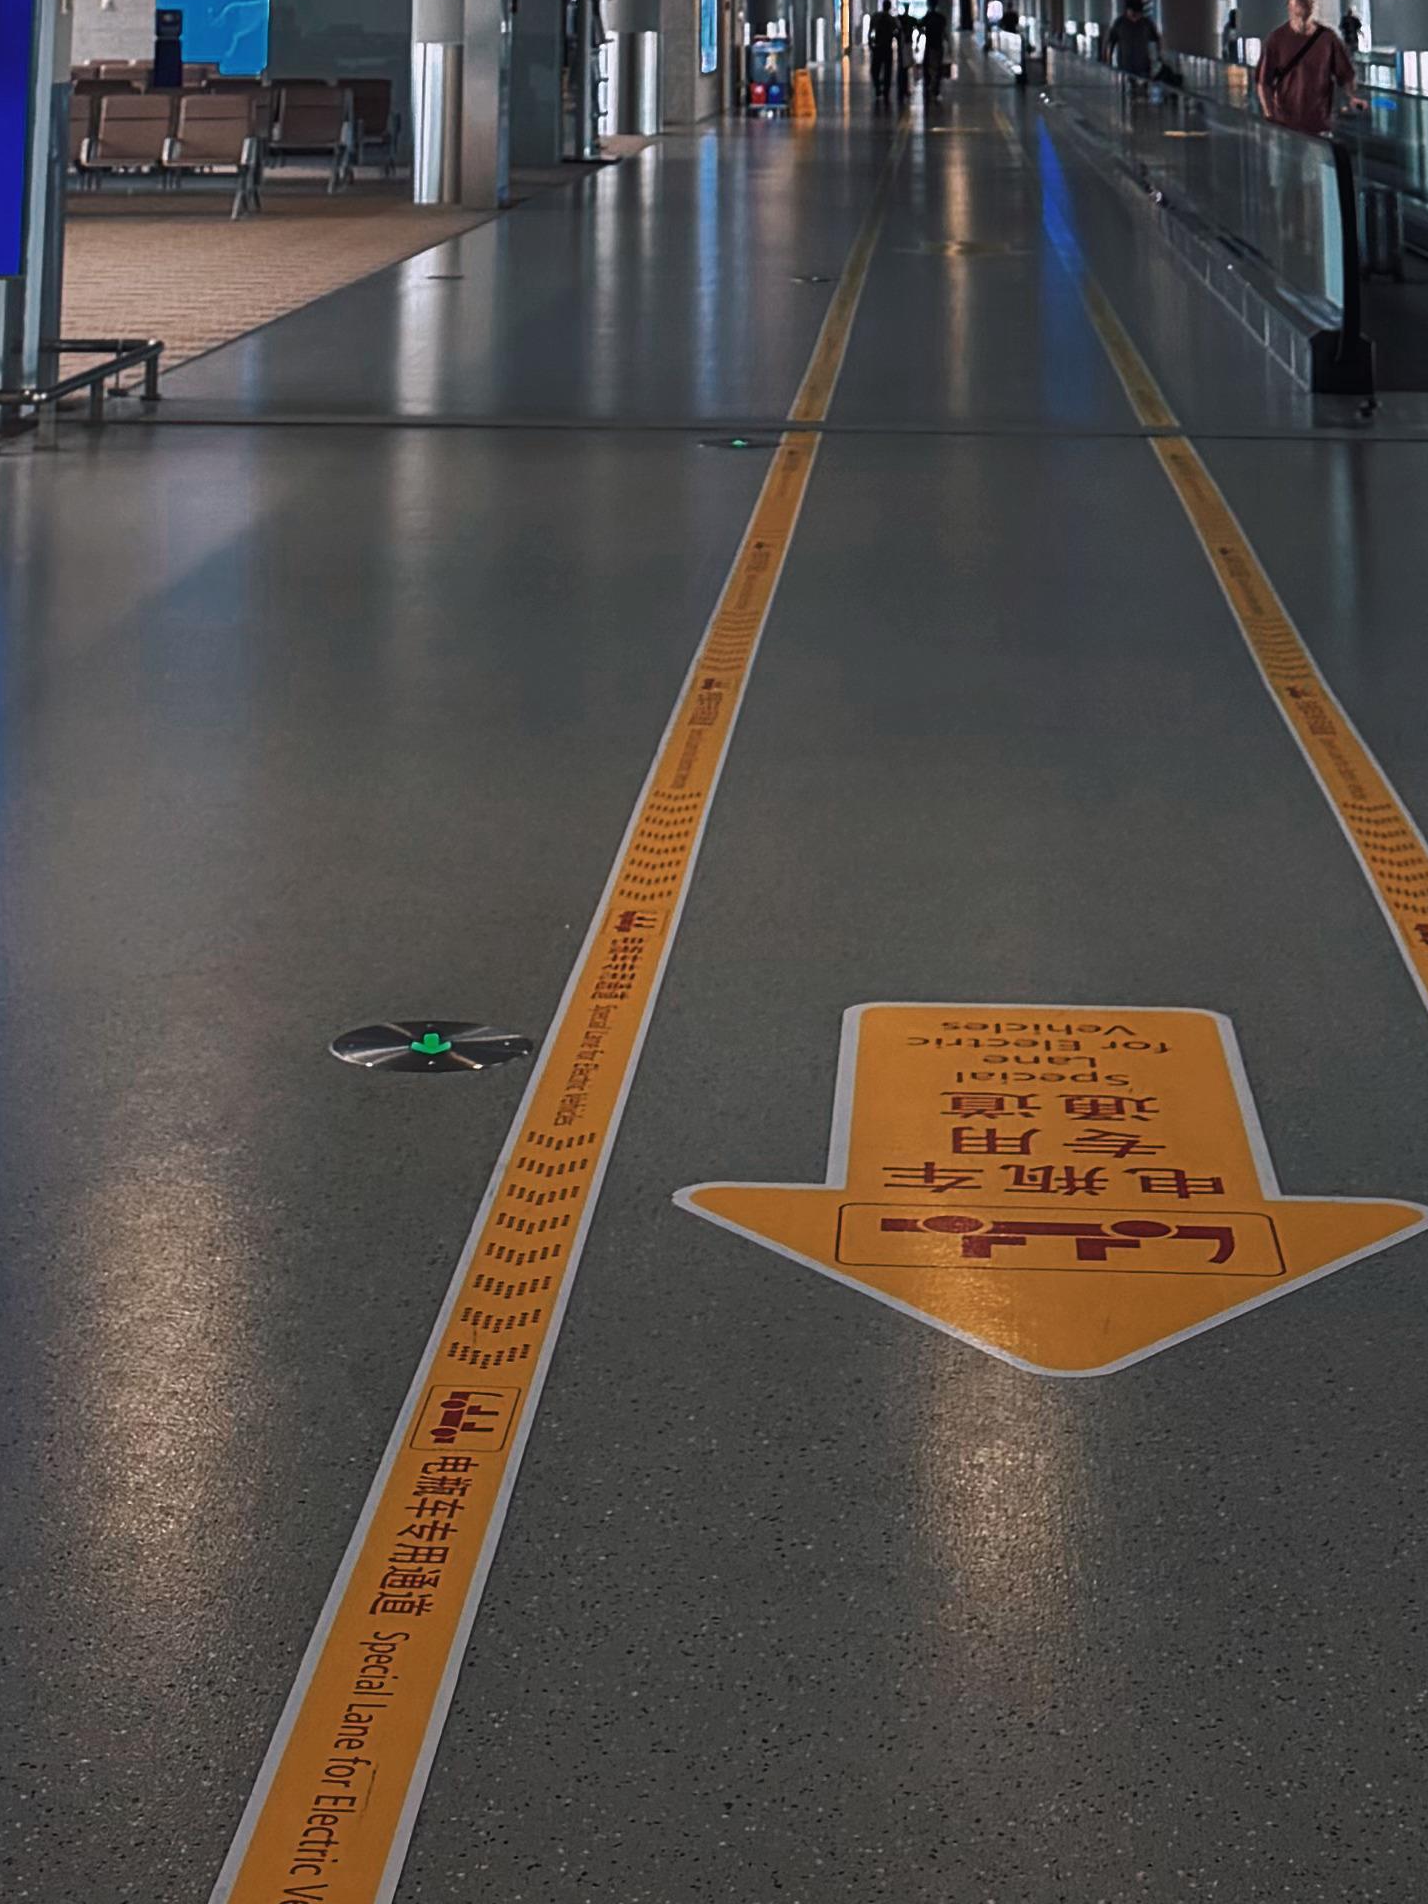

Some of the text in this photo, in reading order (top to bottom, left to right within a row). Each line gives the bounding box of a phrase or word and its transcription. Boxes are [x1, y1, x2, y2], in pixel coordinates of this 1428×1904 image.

[942, 1022, 1136, 1036] Vehicles
[907, 1036, 1172, 1055] for Electric
[983, 1055, 1097, 1068] Lane
[956, 1070, 1130, 1087] Special
[940, 1091, 1160, 1122] 通道
[952, 1127, 1166, 1159] 专用
[882, 1162, 1226, 1200] 电瓶车
[369, 1455, 479, 1617] 电瓶车专用通道
[354, 1631, 410, 1697] Special
[333, 1703, 387, 1751] Lane
[321, 1756, 371, 1788] for
[289, 1794, 357, 1876] Electric
